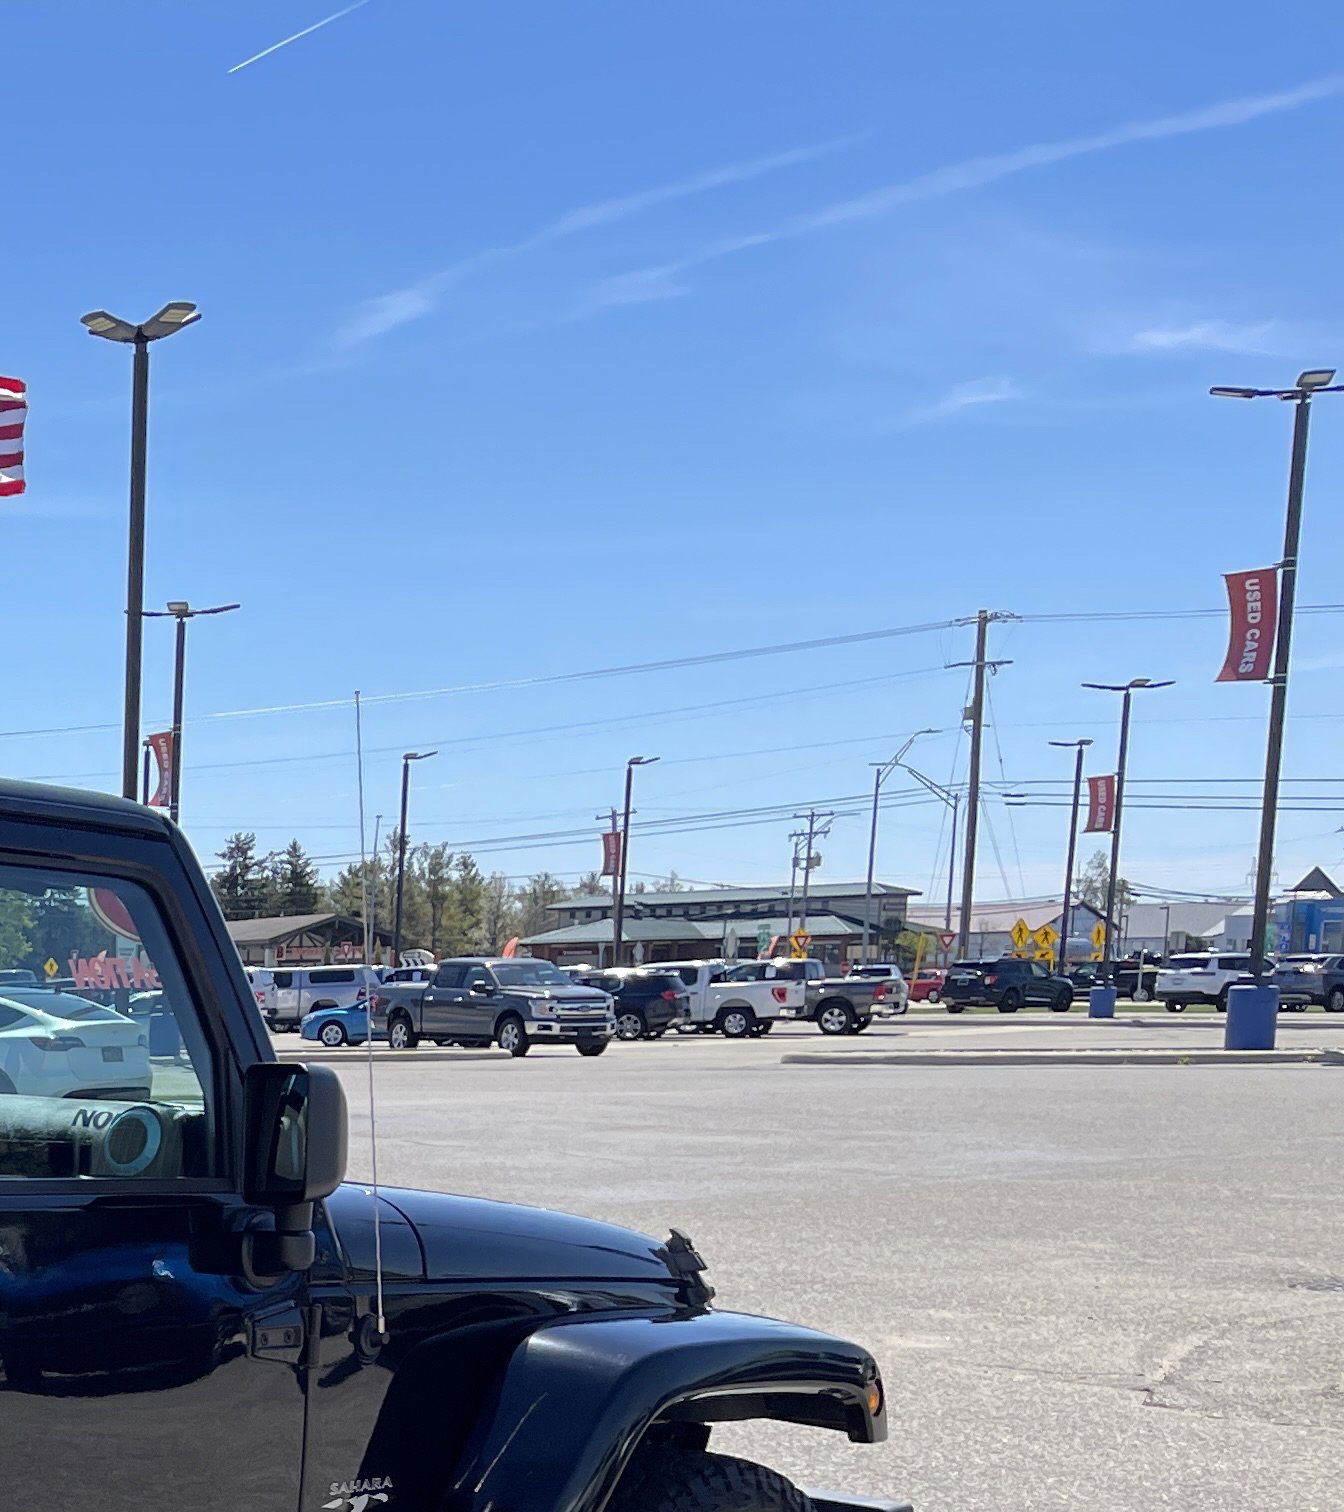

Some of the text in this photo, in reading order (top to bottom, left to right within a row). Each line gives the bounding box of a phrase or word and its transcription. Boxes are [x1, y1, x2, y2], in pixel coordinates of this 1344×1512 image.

[1238, 578, 1262, 674] USED CARS
[329, 1476, 394, 1496] SAHARA
